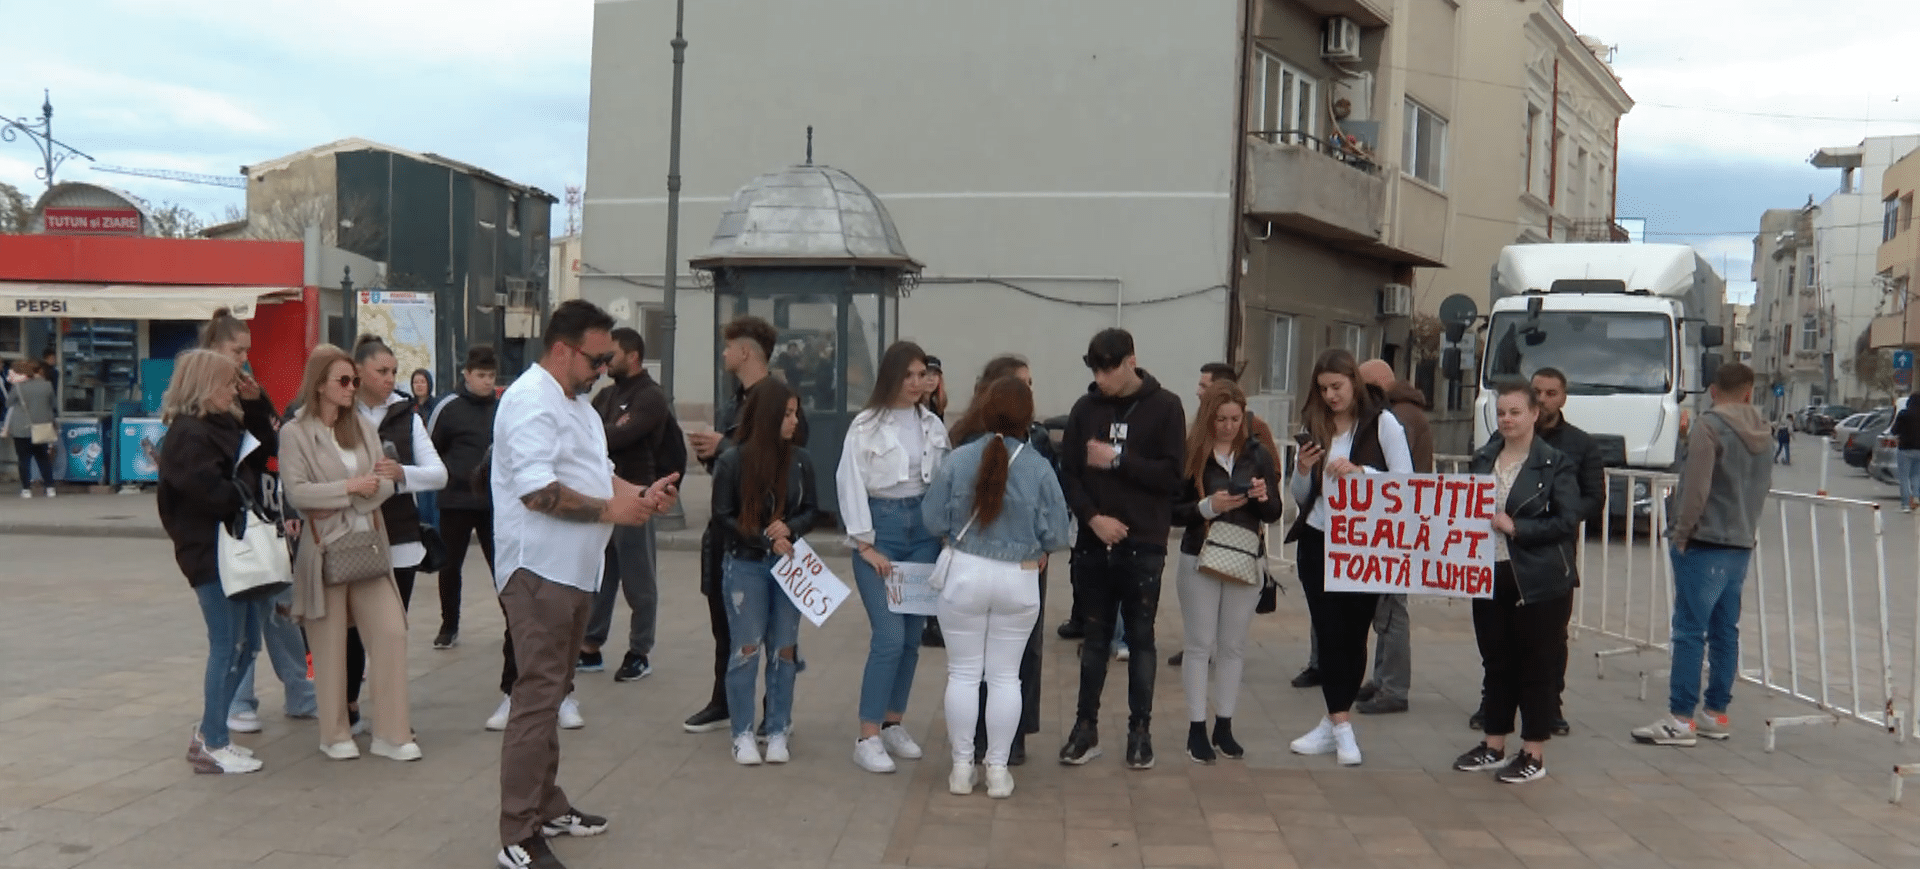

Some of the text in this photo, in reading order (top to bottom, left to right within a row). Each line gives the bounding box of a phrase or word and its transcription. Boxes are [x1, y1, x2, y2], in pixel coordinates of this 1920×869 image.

[48, 216, 88, 228] TUTUN
[102, 216, 137, 229] ZIARE
[16, 299, 67, 312] PEPSI
[802, 553, 822, 575] NO
[778, 557, 833, 616] DRUGS
[1421, 559, 1492, 594] LUMEA
